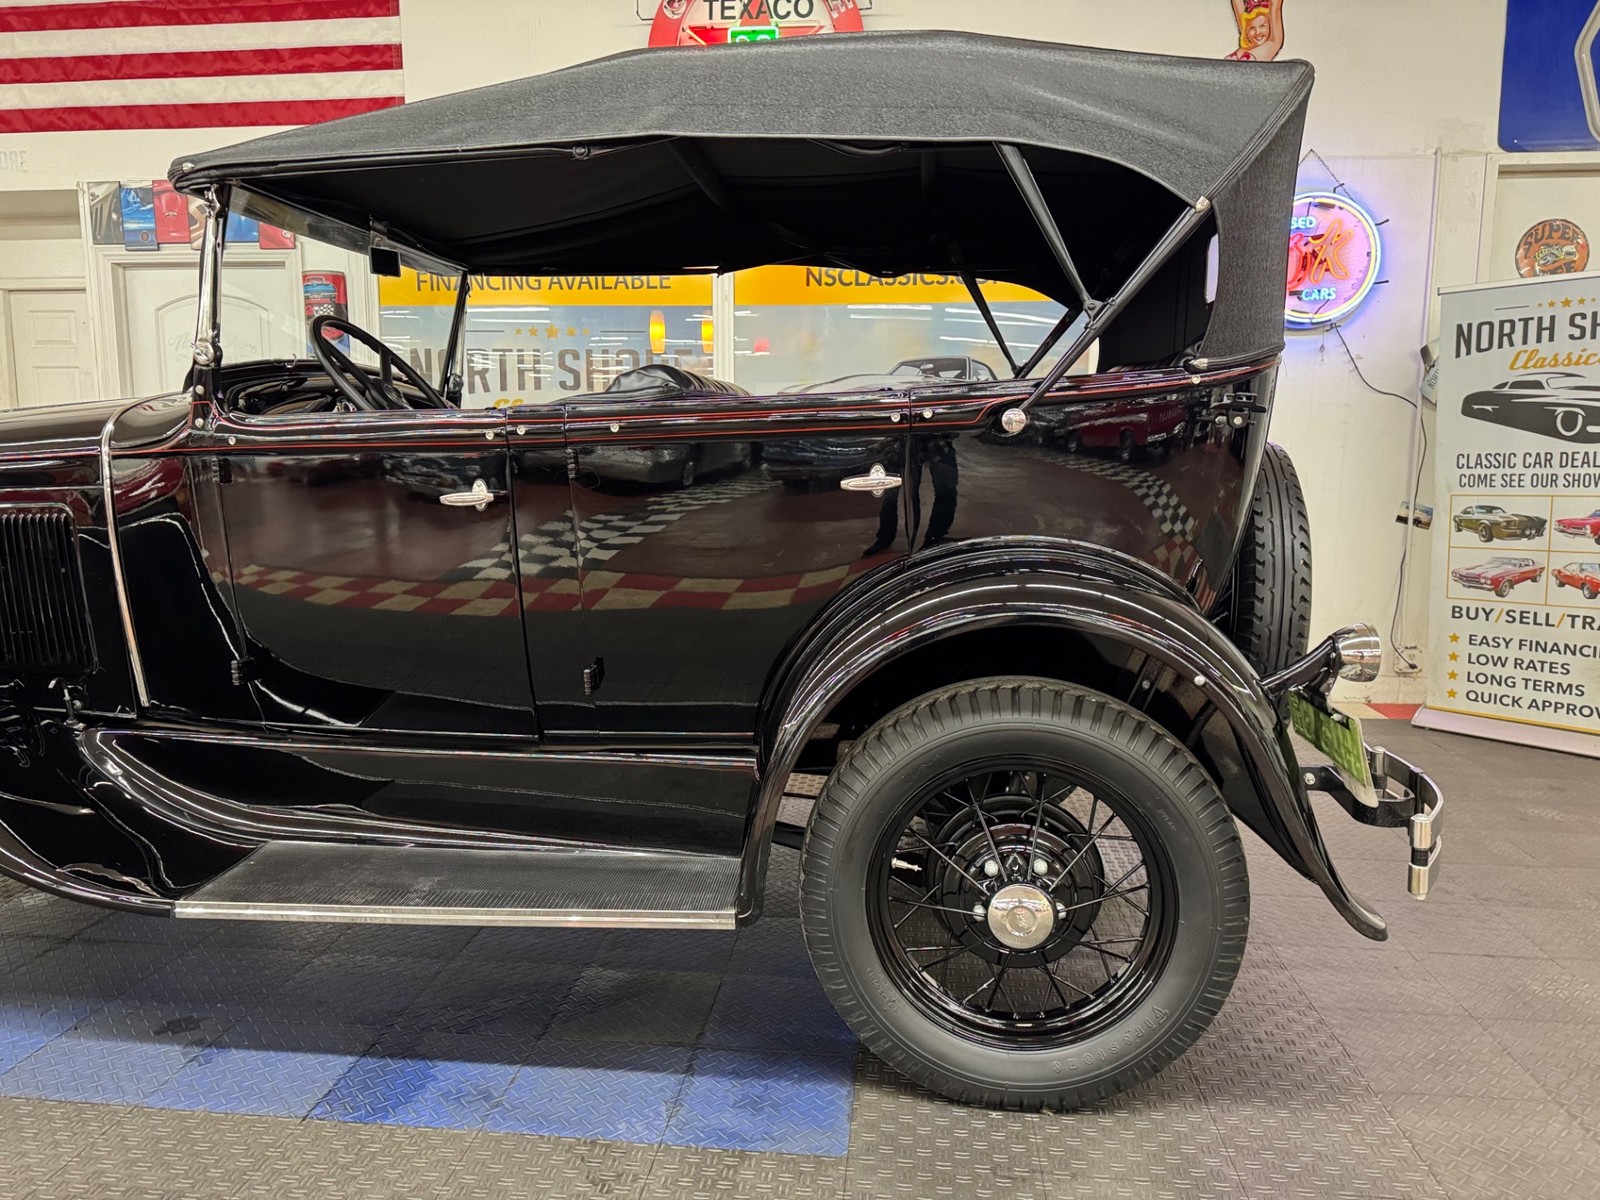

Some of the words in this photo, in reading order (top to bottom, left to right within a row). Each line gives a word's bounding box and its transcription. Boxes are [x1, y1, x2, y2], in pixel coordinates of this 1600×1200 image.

[705, 0, 814, 20] TEXACO
[547, 275, 672, 290] AVAILABLE
[1301, 288, 1337, 301] CARS
[1455, 314, 1556, 359] NORTH
[1509, 348, 1600, 371] Classic
[1456, 452, 1517, 469] CLASSIC
[1522, 452, 1554, 469] CAR
[1459, 473, 1497, 488] COME
[1500, 473, 1526, 488] SEE
[1530, 473, 1558, 488] OUR
[1468, 634, 1513, 649] EASY
[1467, 652, 1509, 668] LOW
[1513, 657, 1571, 676] RATES
[1466, 671, 1517, 689] LONG
[1521, 677, 1585, 697] TERMS
[1465, 690, 1523, 709] QUICK
